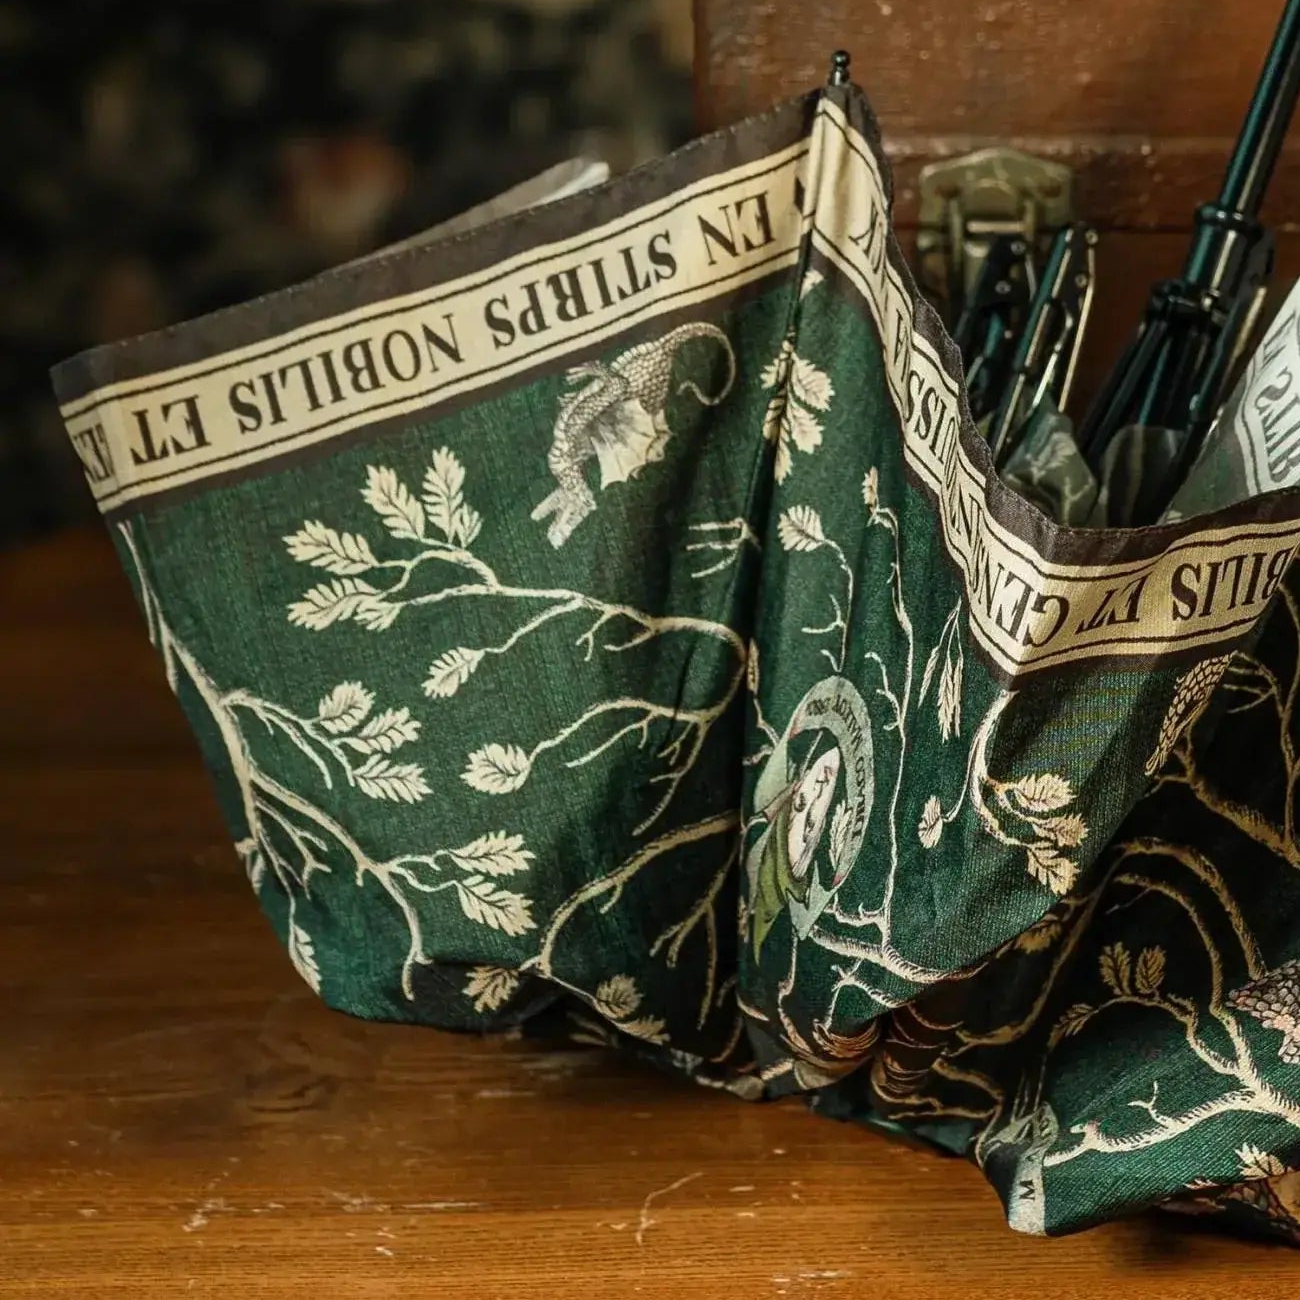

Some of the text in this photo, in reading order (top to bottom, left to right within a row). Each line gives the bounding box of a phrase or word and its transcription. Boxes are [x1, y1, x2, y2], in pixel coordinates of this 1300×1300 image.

[698, 190, 774, 267] EN
[485, 228, 680, 350] STIRPS
[227, 312, 467, 436] NOBILIS
[130, 394, 213, 468] ET
[1077, 573, 1148, 633] ET
[1171, 548, 1294, 623] BILIS
